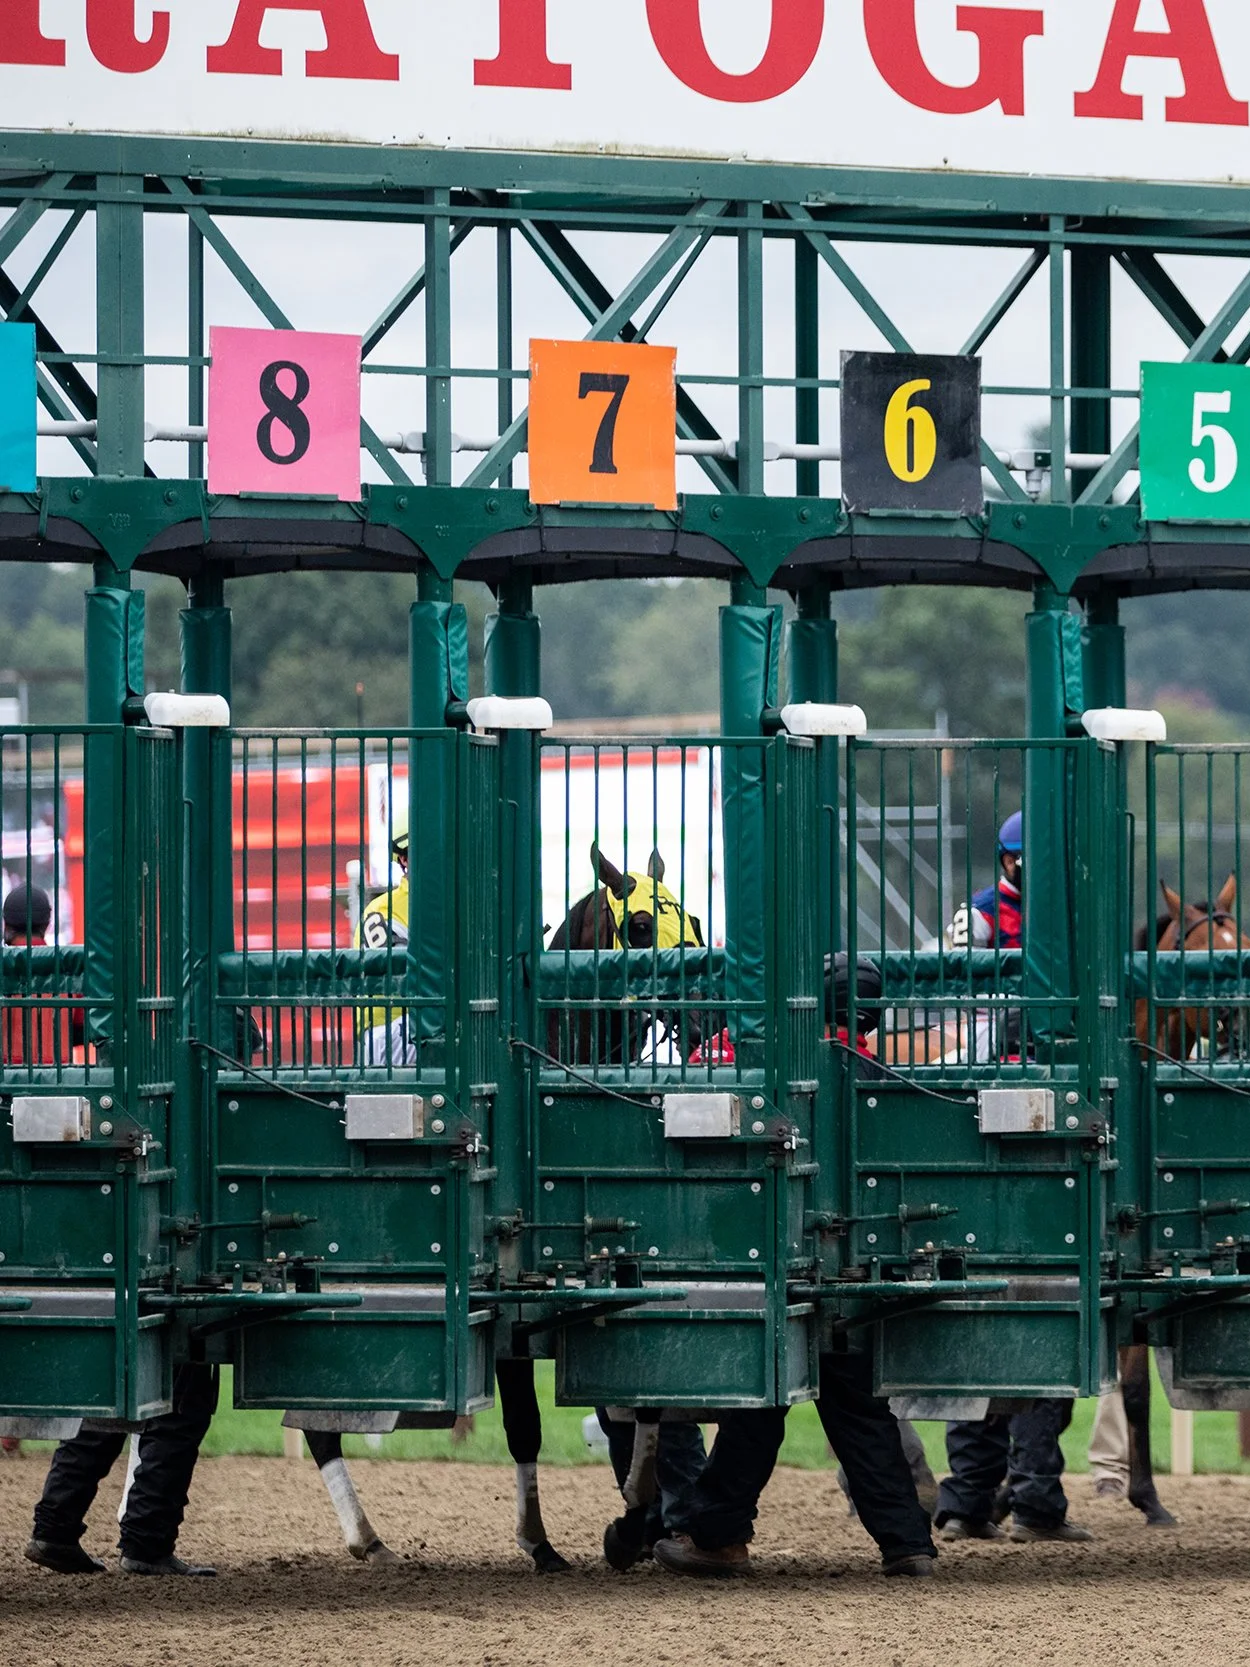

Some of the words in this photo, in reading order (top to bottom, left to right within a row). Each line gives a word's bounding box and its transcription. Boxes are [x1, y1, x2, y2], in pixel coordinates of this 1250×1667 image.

[257, 361, 310, 465] 8
[579, 372, 629, 473] 7
[884, 379, 936, 482] 6
[1188, 391, 1237, 493] 5
[363, 912, 388, 949] 6
